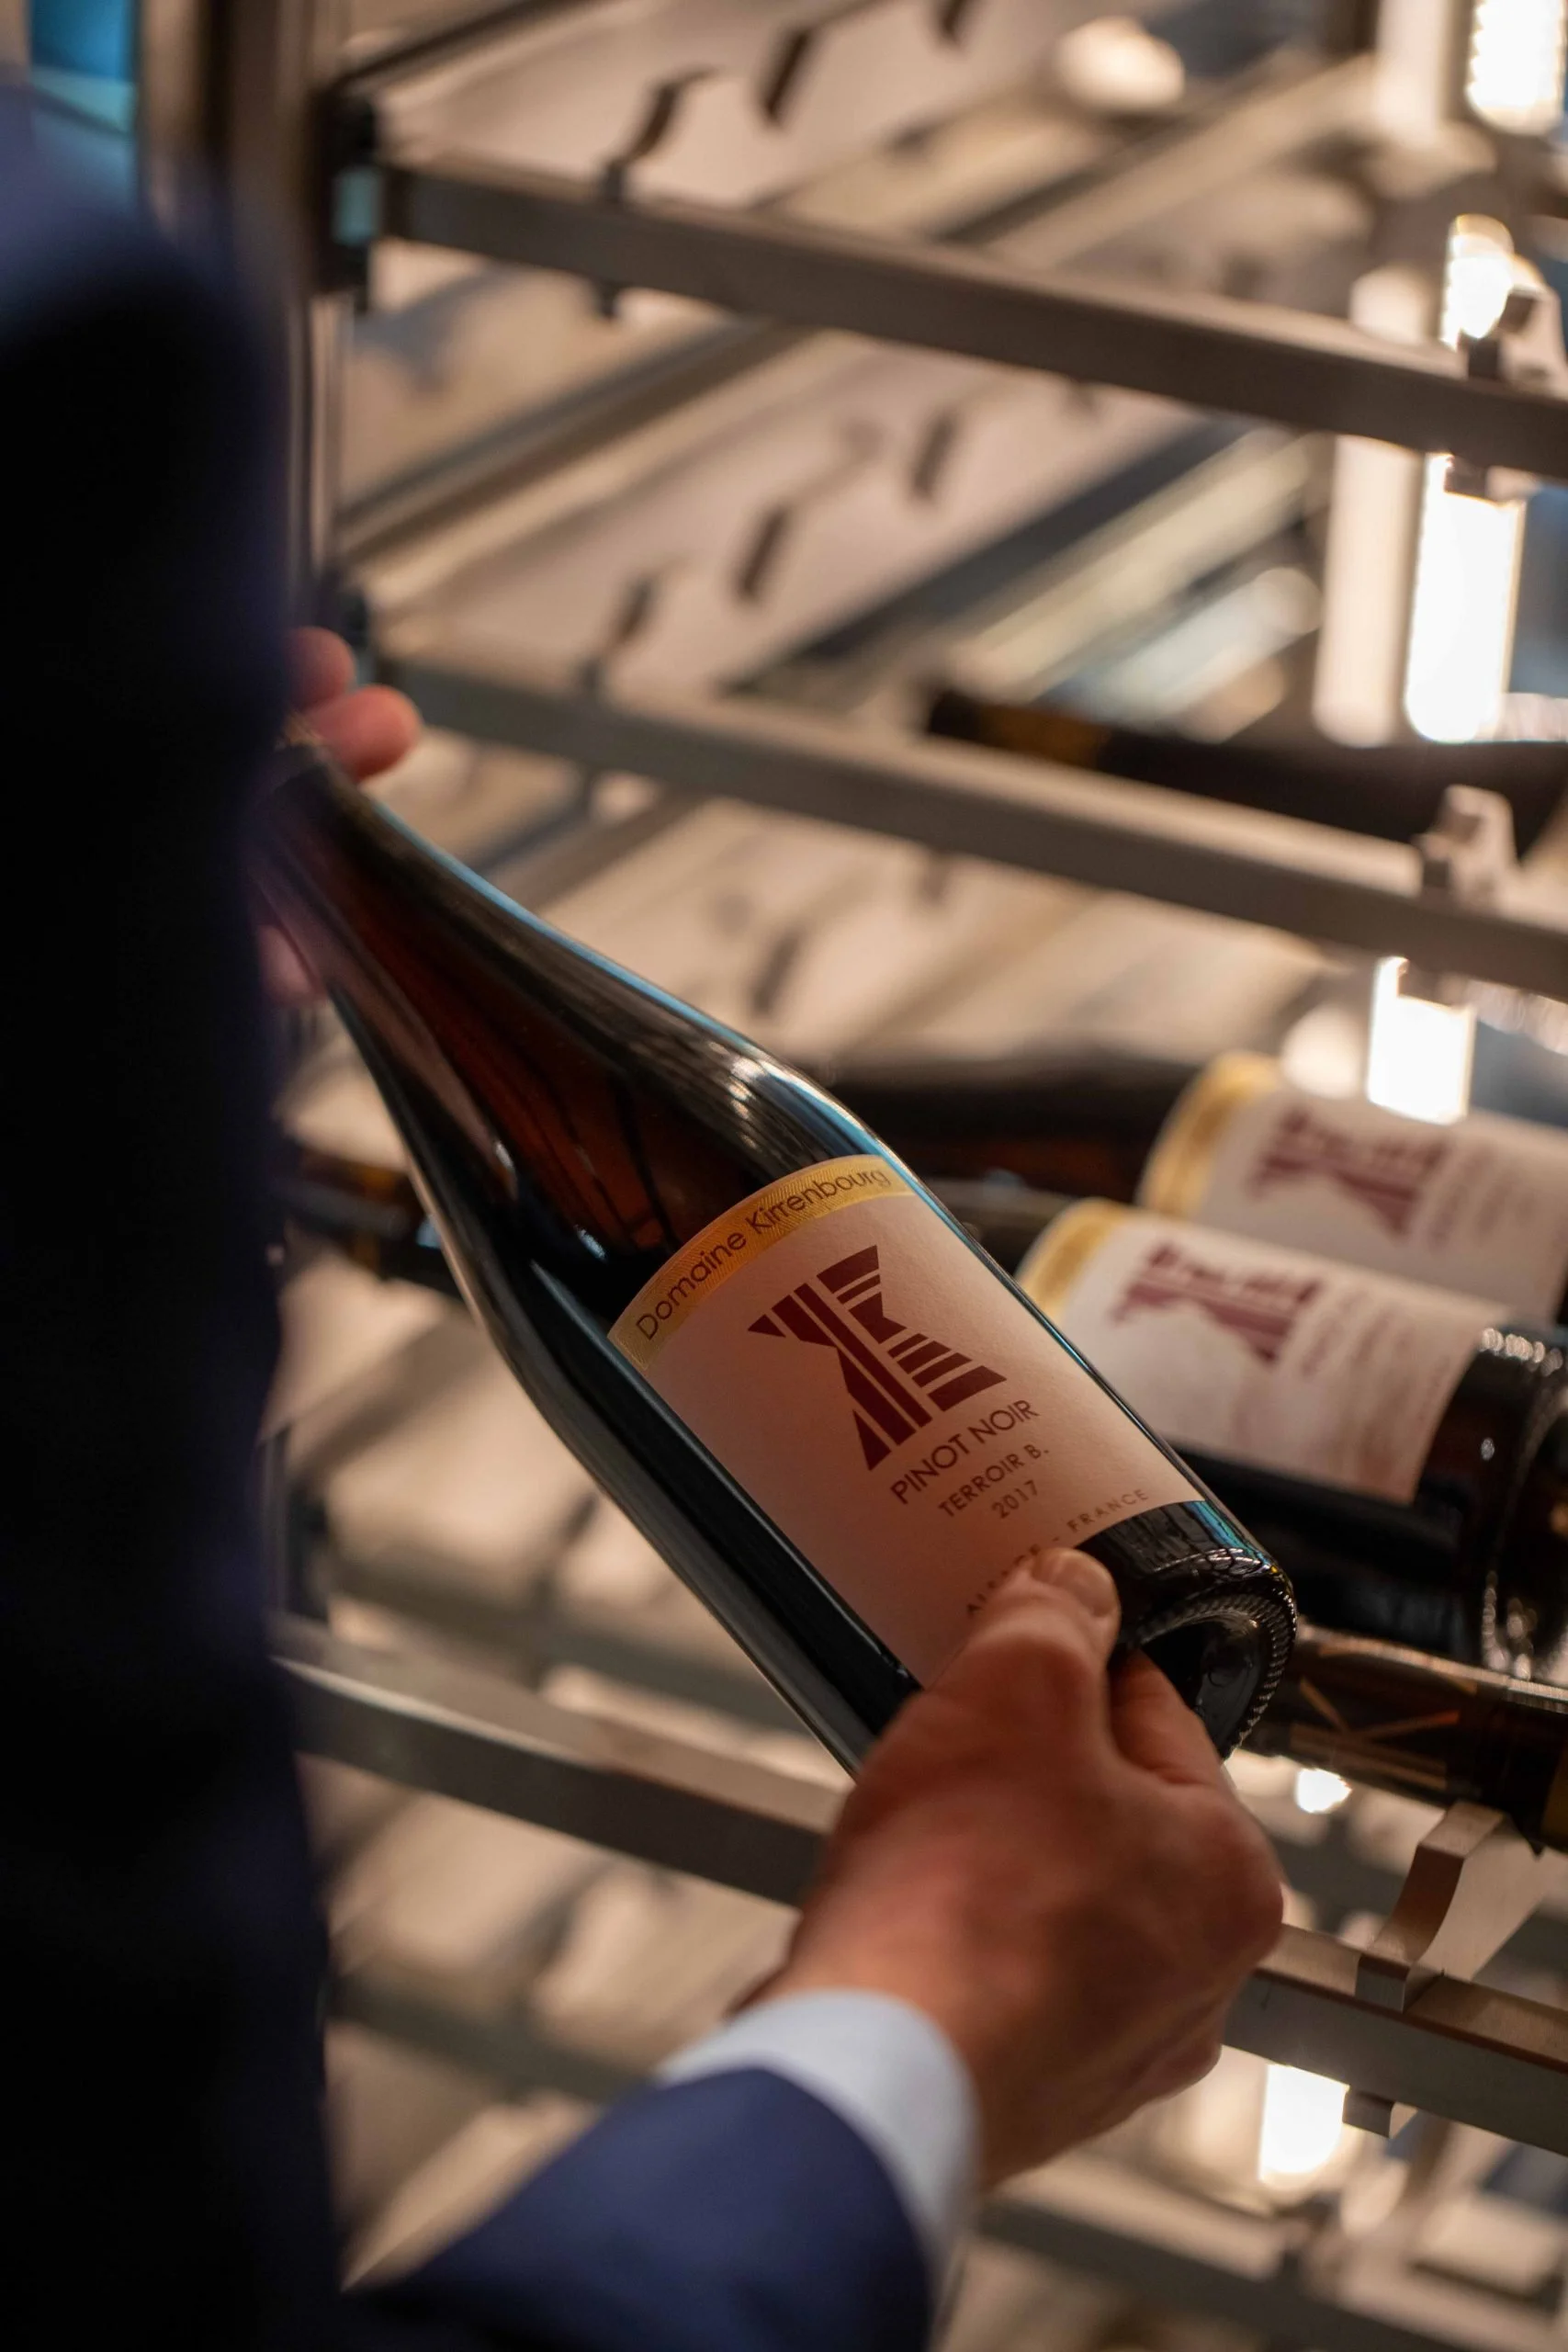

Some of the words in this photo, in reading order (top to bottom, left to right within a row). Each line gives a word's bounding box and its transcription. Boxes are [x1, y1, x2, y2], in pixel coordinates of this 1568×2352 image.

[636, 1231, 747, 1340] Domaine
[745, 1168, 892, 1234] Kirrenbourg
[890, 1433, 969, 1505] PINOT
[967, 1399, 1040, 1444] NOIR
[938, 1453, 1025, 1517] TERROIR
[1023, 1443, 1050, 1460] B.
[991, 1479, 1038, 1519] 2017
[1066, 1488, 1148, 1532] FRANCE
